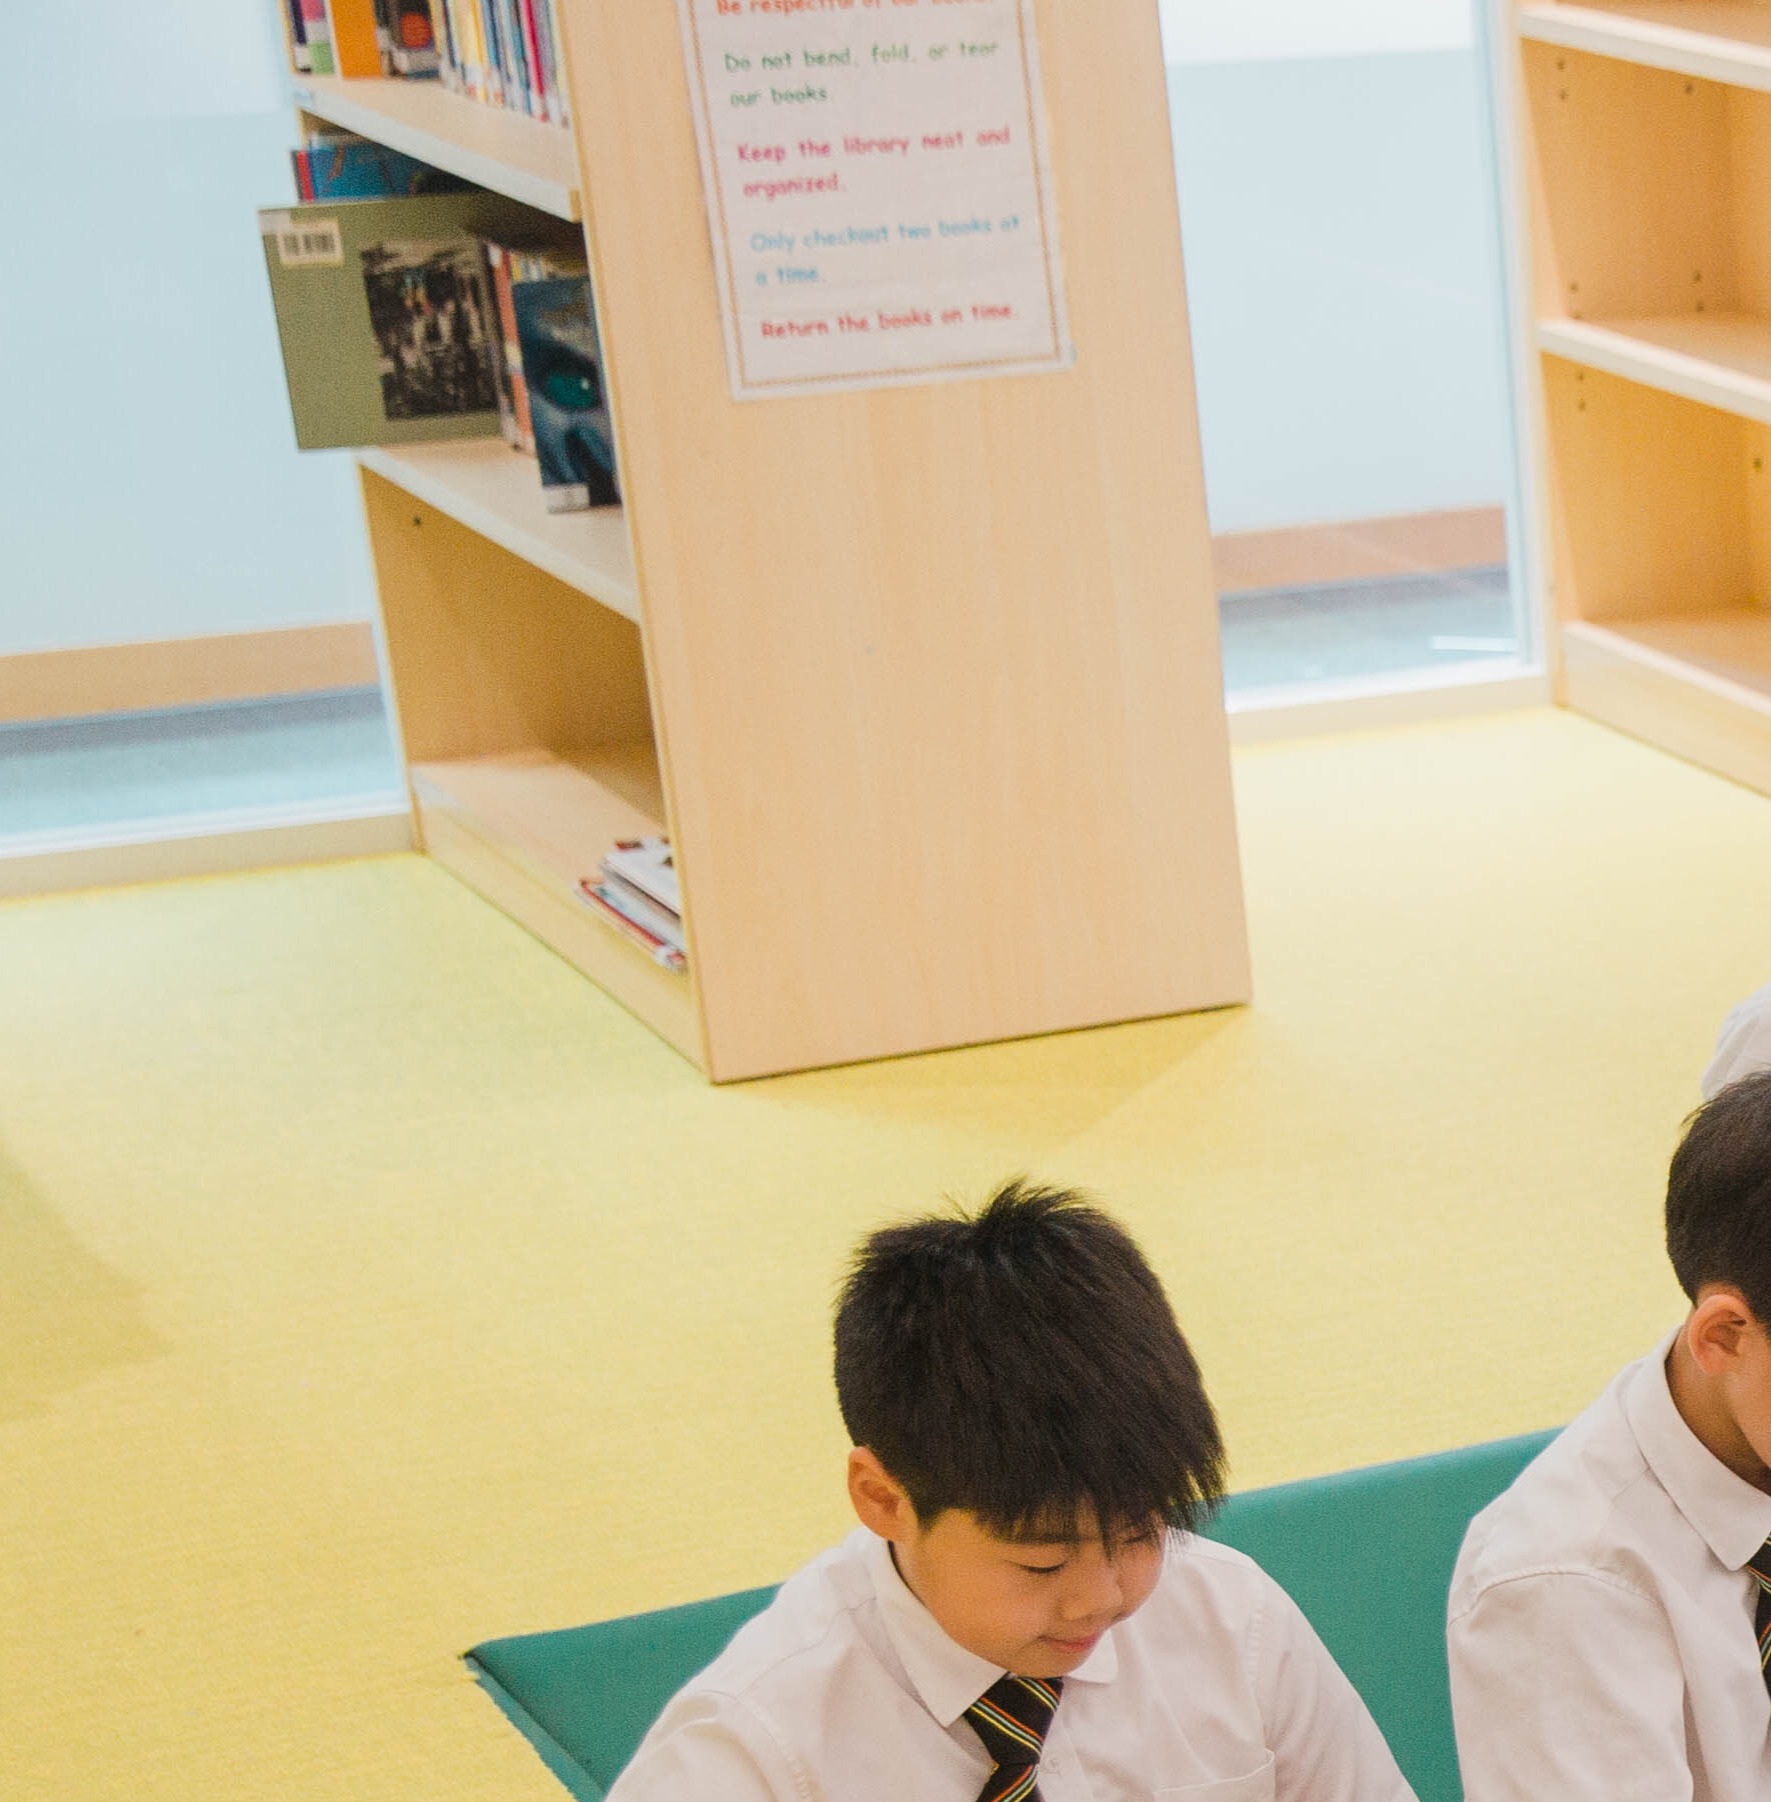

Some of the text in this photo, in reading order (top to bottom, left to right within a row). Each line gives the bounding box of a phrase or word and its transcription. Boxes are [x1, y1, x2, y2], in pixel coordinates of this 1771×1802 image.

[725, 52, 750, 72] Do
[761, 52, 791, 70] not
[929, 45, 947, 60] or
[960, 41, 997, 58] tear
[730, 89, 760, 107] our
[737, 124, 1010, 165] Keep the library neat and
[751, 215, 1019, 254] Only checkout two books at
[756, 272, 768, 286] a
[761, 318, 828, 339] Return
[837, 314, 869, 333] the
[877, 307, 931, 331] books
[940, 307, 962, 324] on
